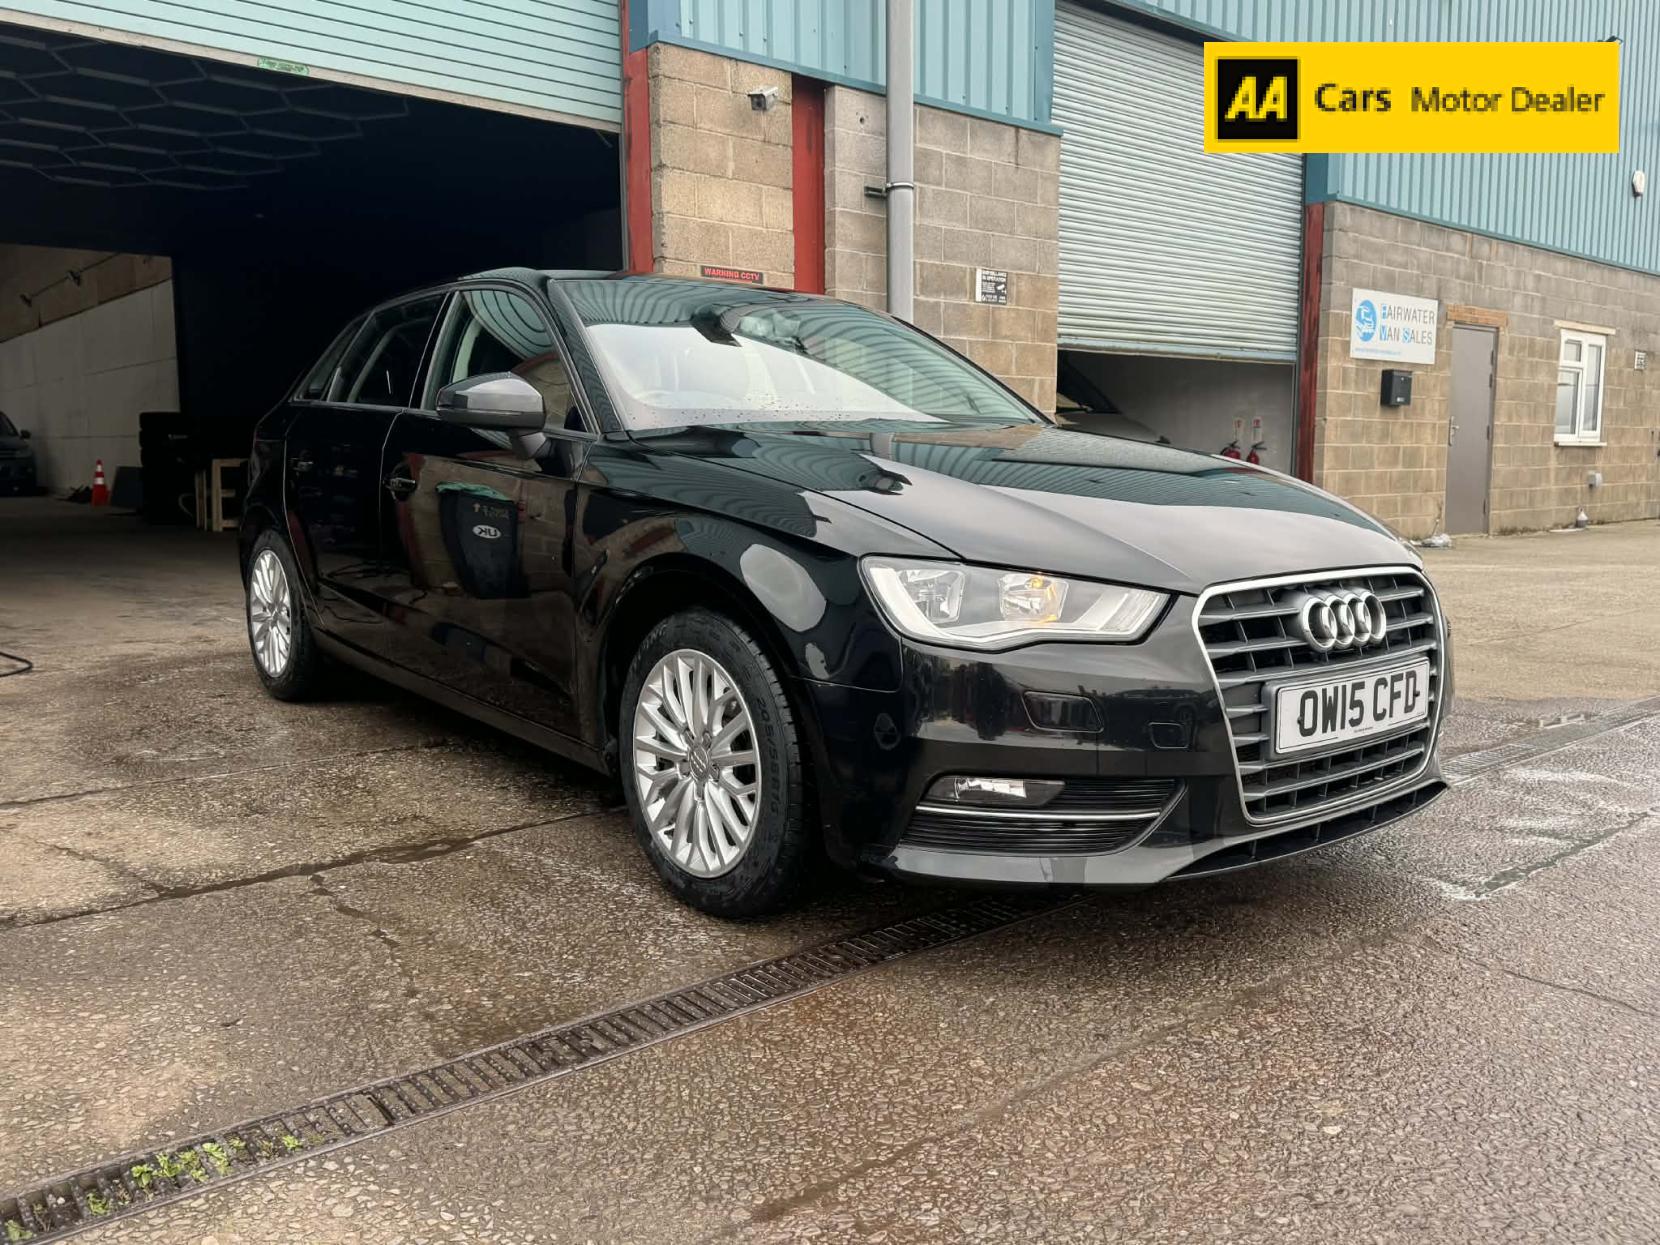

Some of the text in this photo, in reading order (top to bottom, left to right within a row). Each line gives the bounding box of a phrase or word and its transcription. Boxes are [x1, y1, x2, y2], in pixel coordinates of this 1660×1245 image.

[704, 267, 760, 281] WARNING CCTV
[1381, 304, 1435, 325] FAIRWATER
[1380, 325, 1433, 345] VAN SALES
[1299, 670, 1418, 737] OW15 CFD
